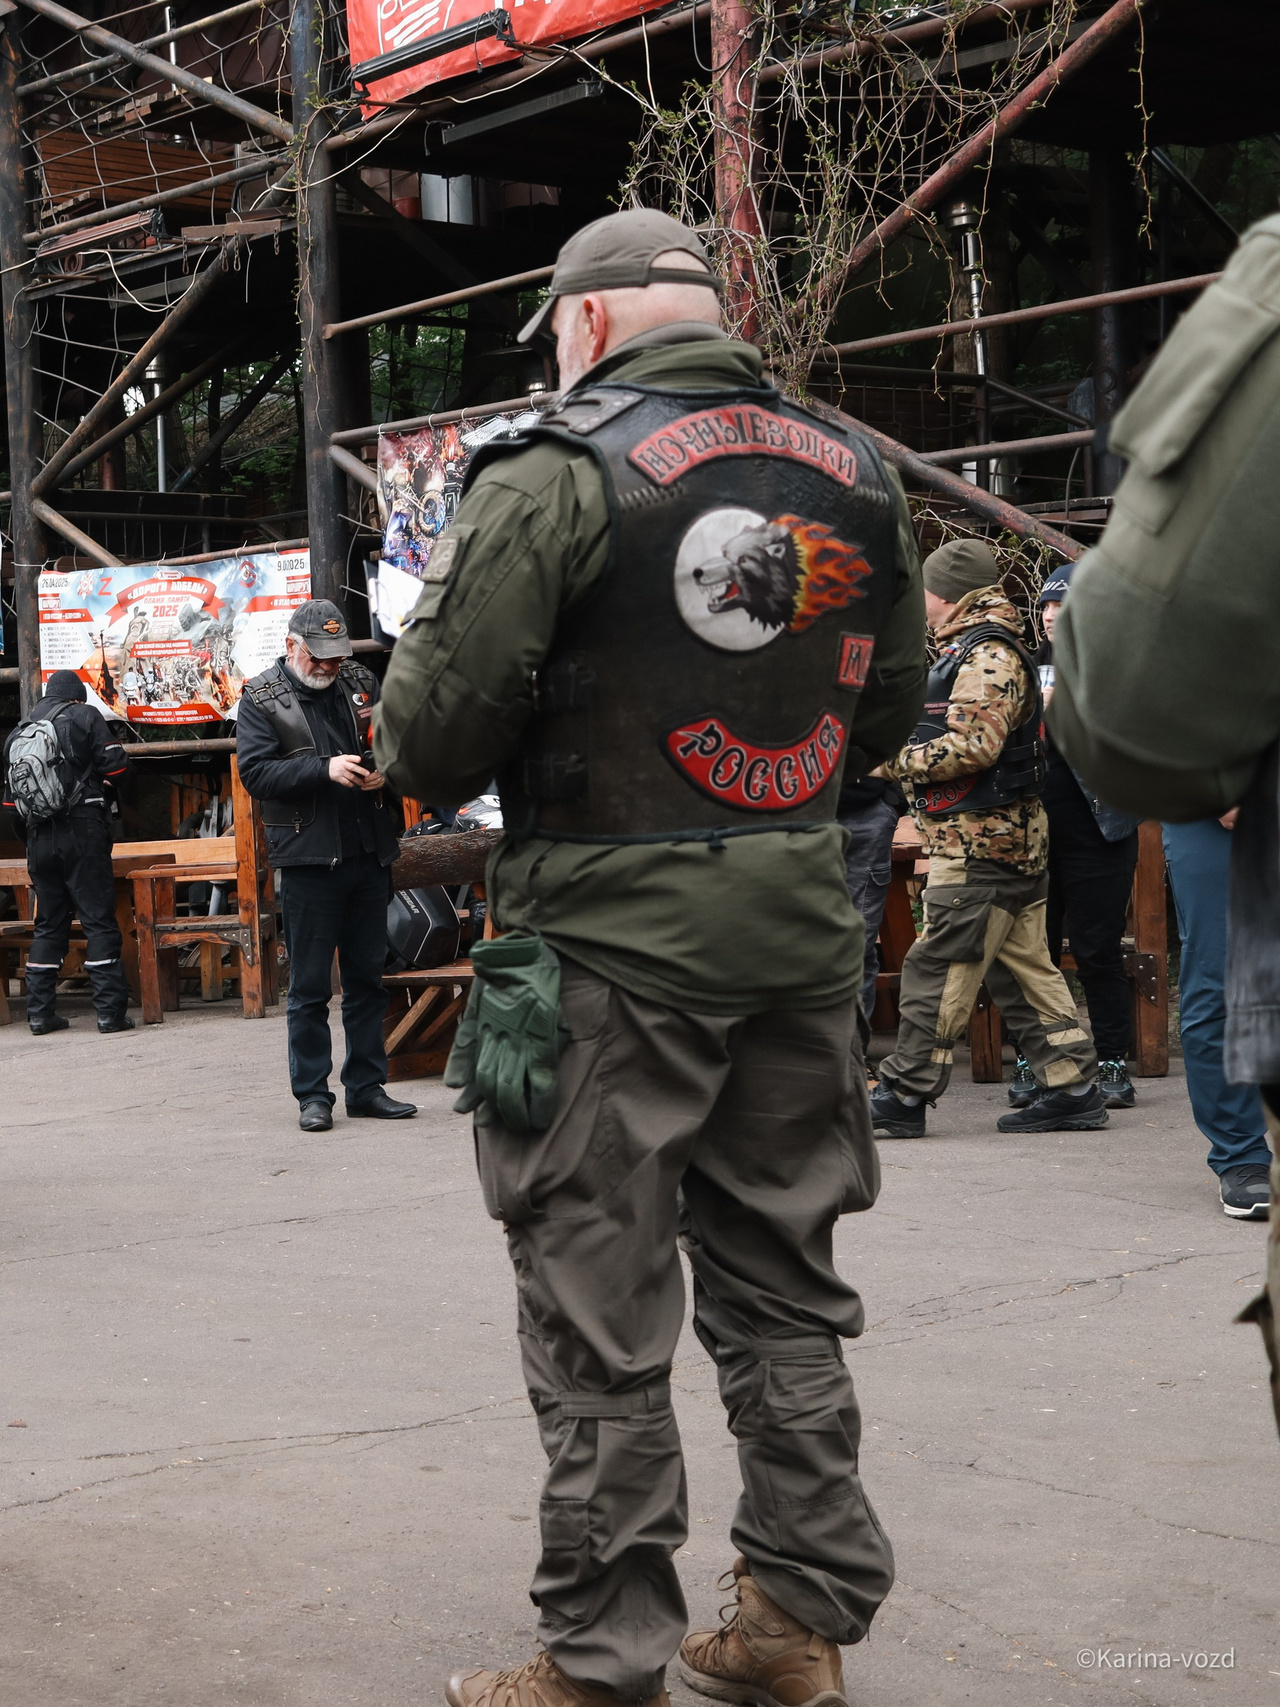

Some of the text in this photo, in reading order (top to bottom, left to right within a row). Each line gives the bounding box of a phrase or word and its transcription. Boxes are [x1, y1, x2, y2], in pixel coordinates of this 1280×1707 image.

[127, 581, 168, 600] «ДОРОГИ
[152, 605, 179, 618] 2025
[676, 714, 843, 803] РОССИЯ
